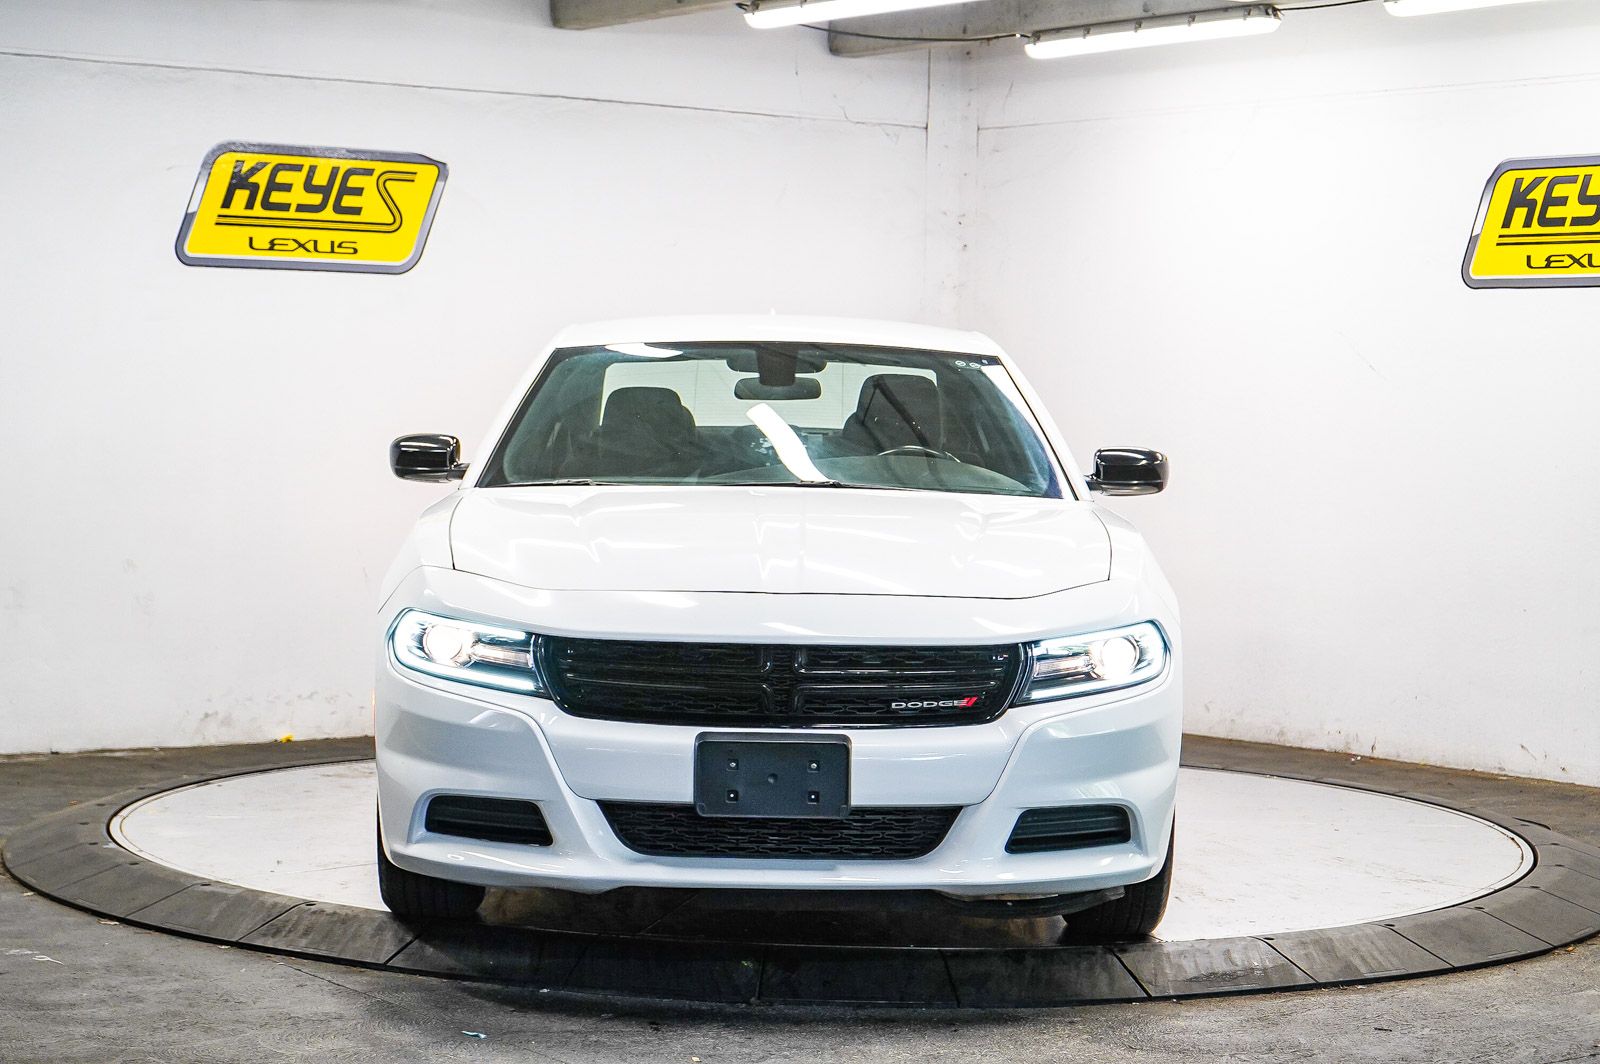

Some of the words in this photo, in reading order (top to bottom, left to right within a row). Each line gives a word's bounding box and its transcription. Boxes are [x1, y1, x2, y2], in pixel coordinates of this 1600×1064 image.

[215, 159, 418, 233] KEYES
[248, 236, 358, 254] LEXUS
[891, 700, 967, 709] DODGE
